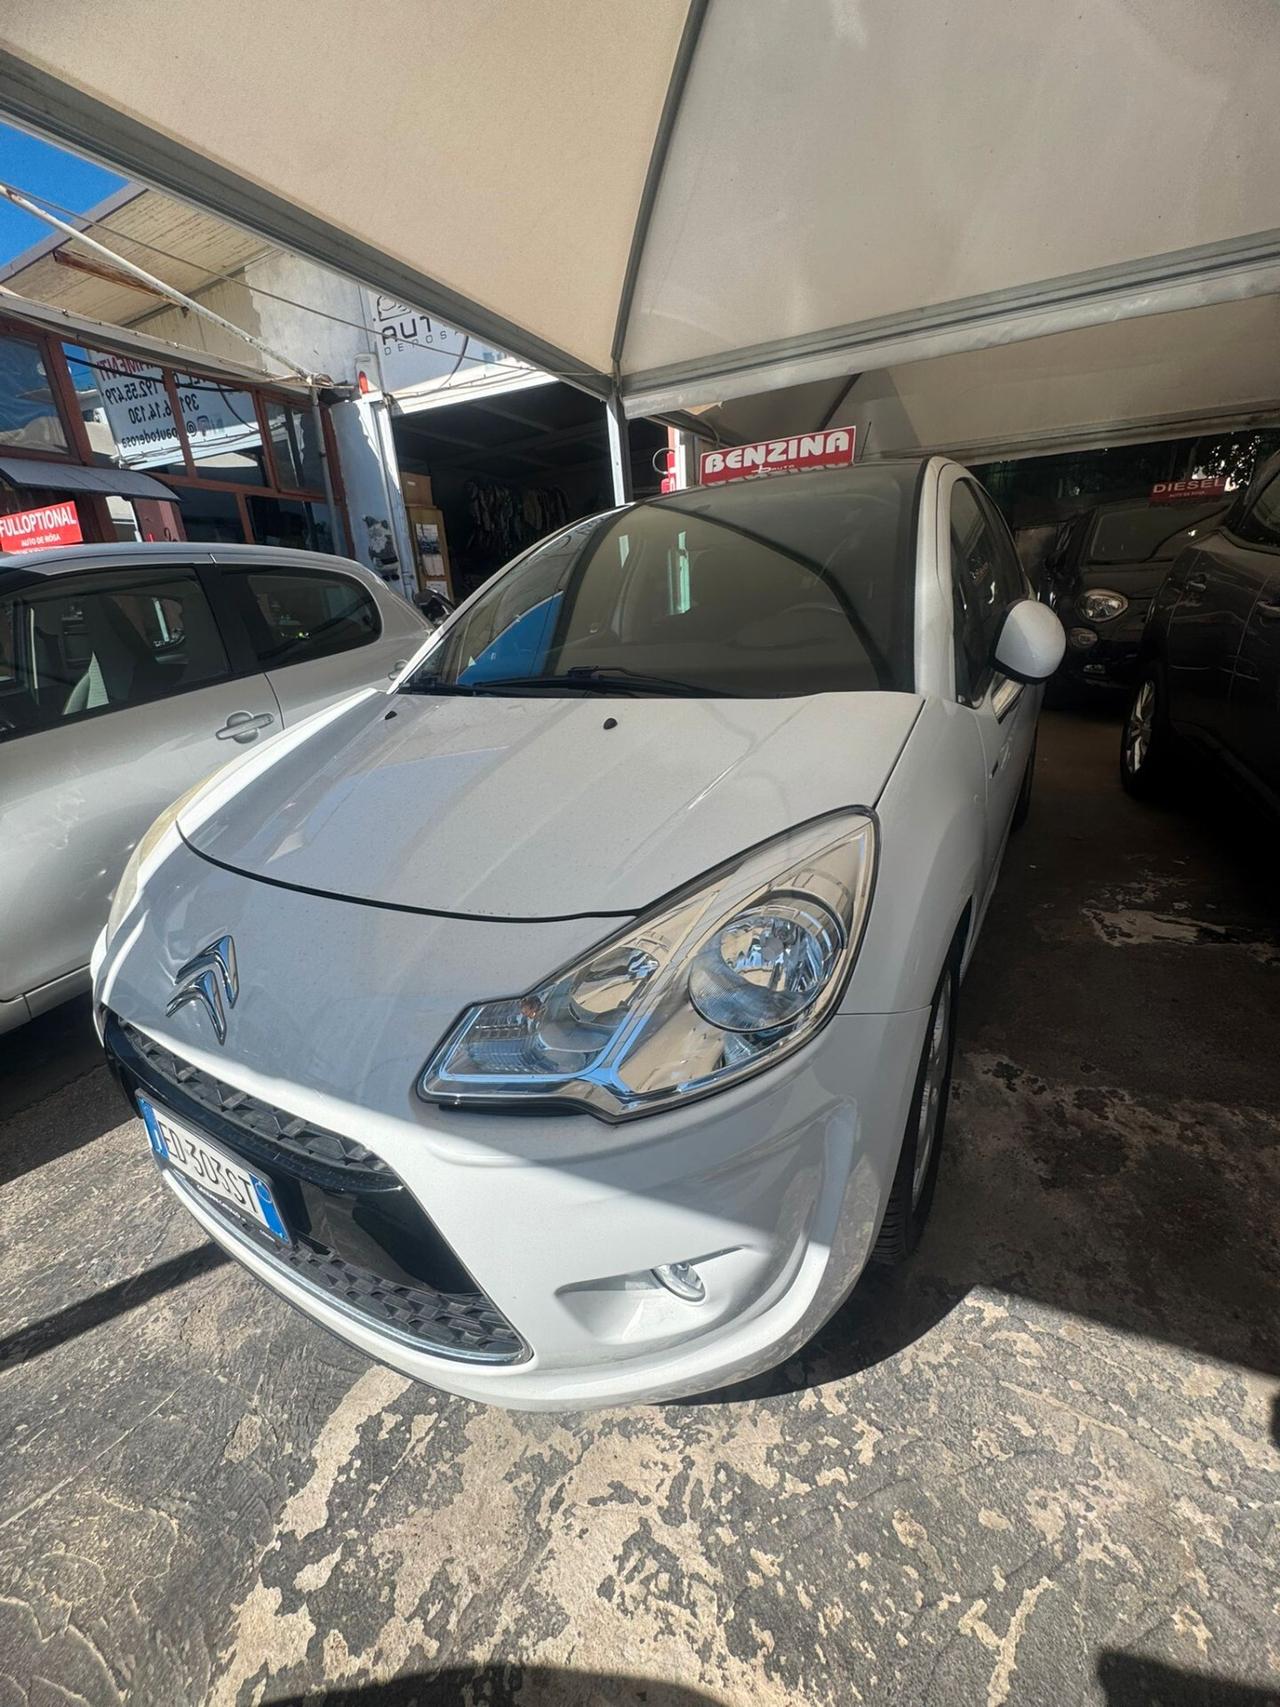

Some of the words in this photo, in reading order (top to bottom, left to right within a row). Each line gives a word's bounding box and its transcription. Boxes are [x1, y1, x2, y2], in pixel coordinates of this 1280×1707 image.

[382, 315, 431, 346] AUT
[384, 331, 458, 357] DEROS
[704, 431, 849, 474] BENZINA
[1153, 478, 1224, 494] DIESEL
[0, 506, 76, 538] FULLOPTIONAL
